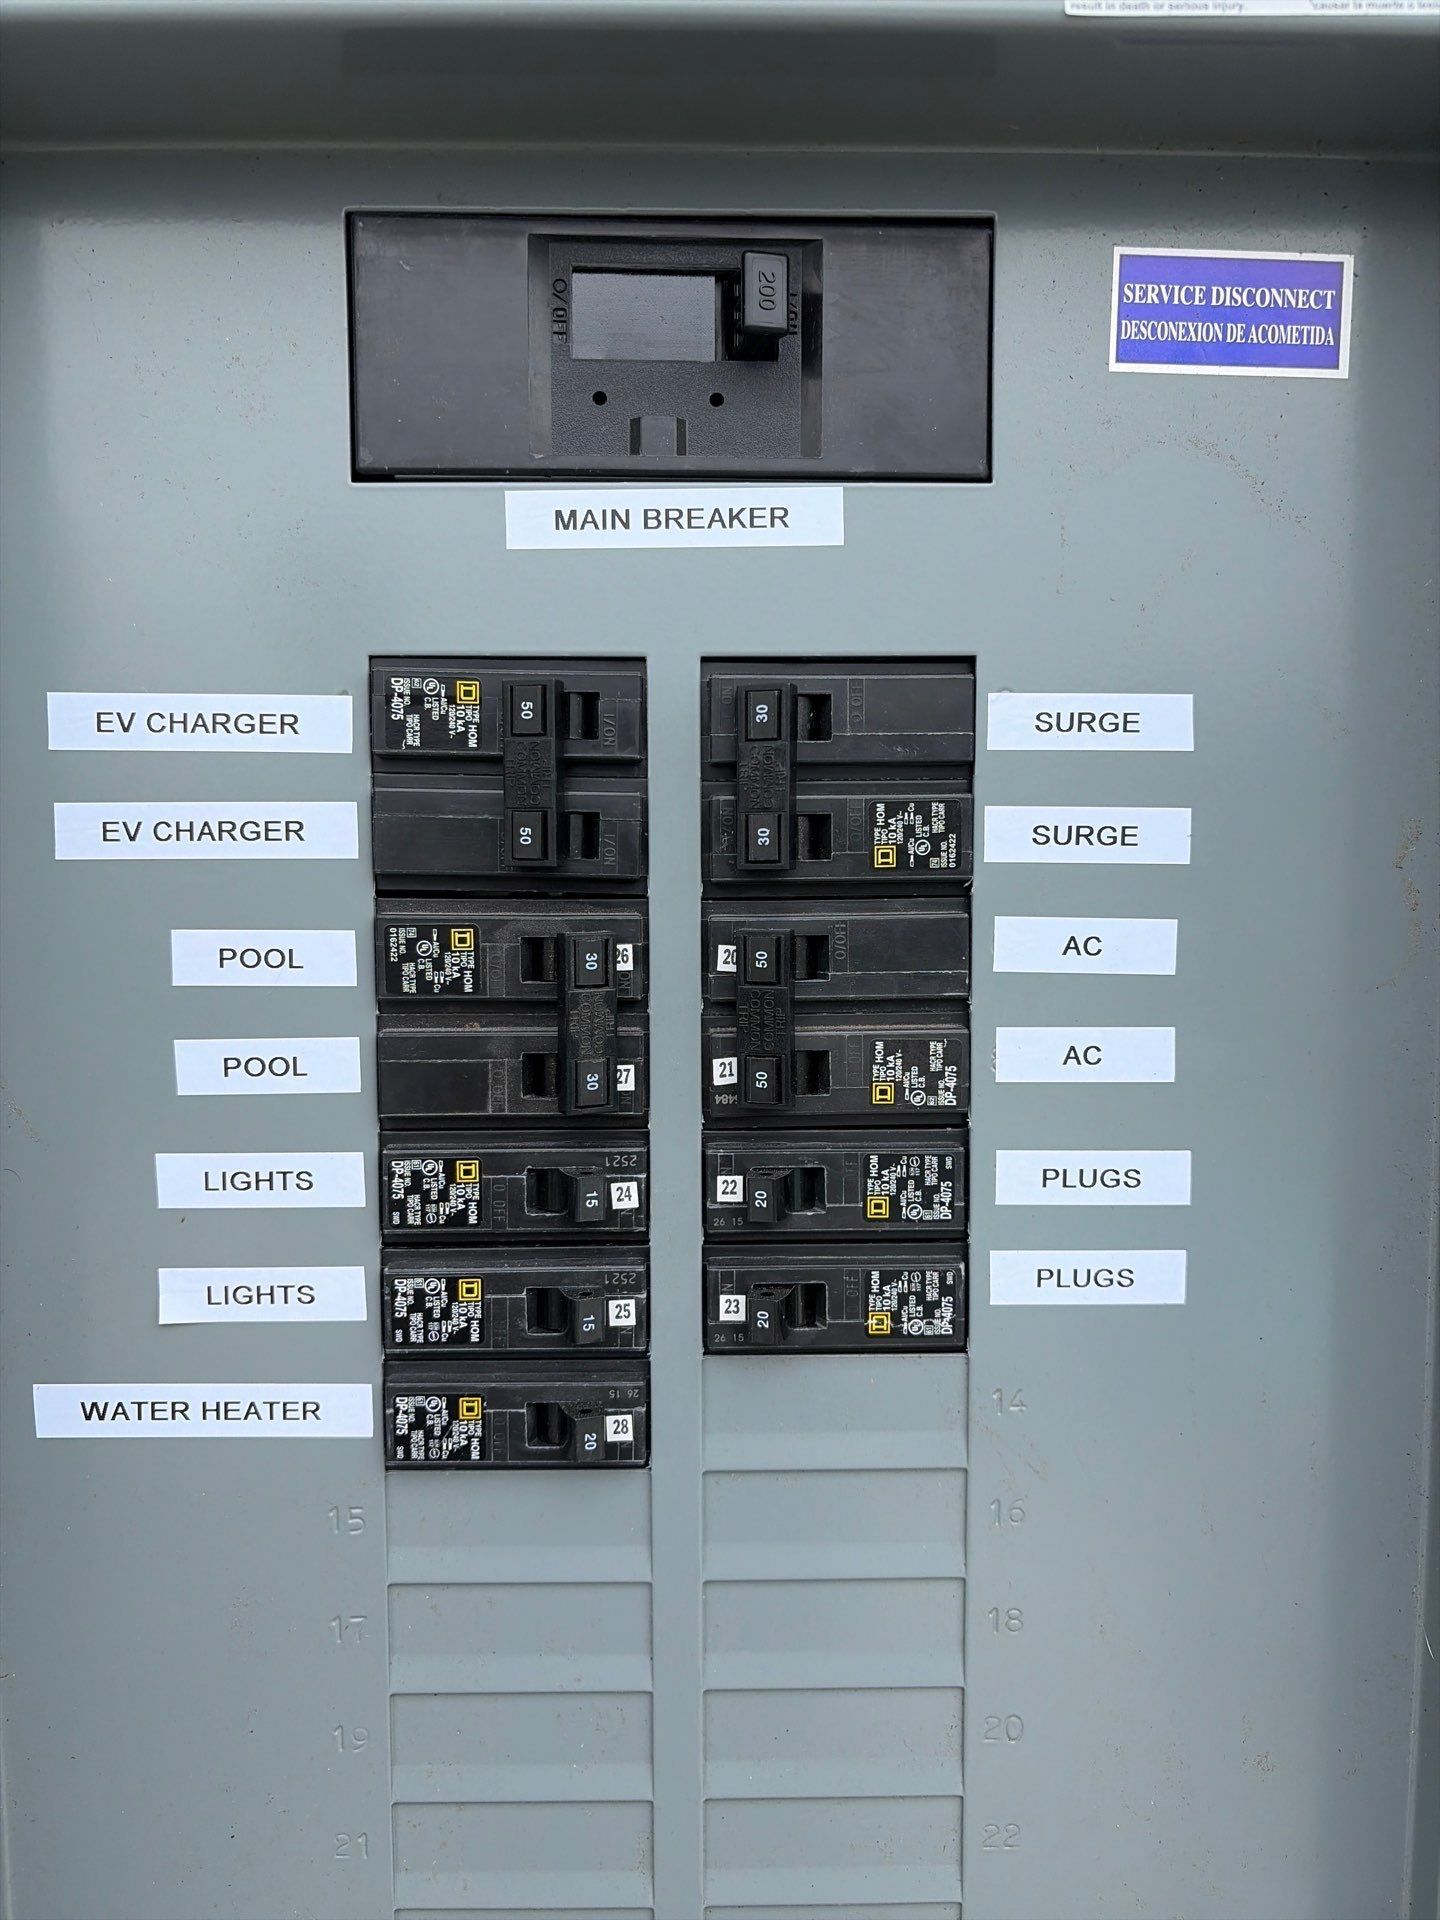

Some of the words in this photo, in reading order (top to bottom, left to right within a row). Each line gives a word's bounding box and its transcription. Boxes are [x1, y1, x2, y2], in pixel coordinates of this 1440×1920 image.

[758, 270, 776, 311] 200
[1123, 283, 1206, 305] SERVICE
[1211, 286, 1336, 309] DISCONNECT
[1121, 320, 1222, 342] DESCONEXION
[1226, 324, 1246, 343] DE
[1248, 324, 1335, 345] ACOMETIDA
[555, 508, 631, 531] MAIN
[643, 506, 790, 530] BREAKER
[391, 678, 403, 720] DP-4075
[456, 705, 465, 717] 10
[521, 702, 533, 719] 50
[756, 704, 768, 723] 30
[96, 712, 137, 732] EV
[146, 712, 300, 734] CHARGER
[456, 720, 465, 732] kA
[604, 714, 616, 746] I/ON
[1034, 712, 1140, 733] SURGE
[469, 725, 477, 747] HOM
[876, 804, 885, 825] HOM
[888, 818, 896, 830] kA
[102, 821, 142, 842] EV
[153, 820, 305, 841] CHARGER
[520, 827, 531, 844] 50
[758, 828, 770, 846] 30
[889, 833, 896, 844] 10
[1032, 825, 1138, 846] SURGE
[604, 835, 615, 865] I/ON
[1062, 936, 1102, 956] AC
[219, 948, 304, 969] POOL
[452, 951, 460, 963] 10
[585, 953, 597, 970] 30
[756, 951, 767, 968] 50
[452, 966, 460, 978] kA
[464, 971, 472, 992] HOM
[875, 1042, 884, 1062] HOM
[887, 1055, 894, 1067] kA
[1063, 1046, 1102, 1066] AC
[223, 1056, 308, 1077] POOL
[719, 1061, 734, 1078] 21
[887, 1070, 895, 1081] 10
[587, 1073, 598, 1090] 30
[617, 1069, 630, 1084] 27
[756, 1072, 767, 1088] 50
[945, 1066, 956, 1105] DP-4075
[715, 1095, 737, 1104] 484
[605, 1155, 637, 1166] 2521
[870, 1155, 878, 1176] HOM
[204, 1171, 314, 1191] LIGHTS
[392, 1161, 404, 1199] DP-4075
[881, 1169, 889, 1181] kA
[1042, 1168, 1142, 1188] PLUGS
[457, 1183, 465, 1195] 10
[616, 1186, 632, 1202] 24
[722, 1180, 737, 1195] 22
[881, 1184, 889, 1195] 10
[457, 1198, 465, 1210] kA
[586, 1191, 598, 1208] 15
[755, 1191, 766, 1208] 20
[940, 1181, 952, 1219] DP-4075
[469, 1202, 477, 1224] HOM
[714, 1218, 725, 1226] 26
[732, 1218, 743, 1226] 15
[605, 1273, 636, 1284] 2521
[871, 1271, 879, 1292] HOM
[1036, 1268, 1134, 1288] PLUGS
[207, 1285, 316, 1305] LIGHTS
[395, 1279, 406, 1317] DP-4075
[883, 1285, 890, 1296] kA
[459, 1302, 467, 1313] 10
[615, 1303, 630, 1319] 25
[725, 1299, 740, 1314] 23
[883, 1299, 890, 1311] 10
[459, 1316, 467, 1328] kA
[583, 1315, 594, 1331] 15
[757, 1311, 769, 1328] 20
[941, 1296, 953, 1334] DP-4075
[471, 1320, 479, 1341] HOM
[715, 1334, 725, 1342] 26
[733, 1333, 744, 1341] 15
[609, 1390, 620, 1398] 15
[992, 1388, 1027, 1415] 14
[80, 1401, 190, 1420] WATER
[202, 1401, 321, 1420] HEATER
[396, 1397, 408, 1435] DP-4075
[460, 1421, 467, 1432] 10
[613, 1419, 628, 1434] 28
[460, 1434, 468, 1446] kA
[471, 1438, 479, 1460] HOM
[585, 1433, 596, 1450] 20
[328, 1506, 367, 1534] 15
[989, 1498, 1025, 1526] 16
[329, 1615, 368, 1643] 17
[987, 1607, 1024, 1634] 18
[332, 1724, 369, 1752] 19
[983, 1715, 1024, 1743] 20
[983, 1823, 1022, 1849] 22
[334, 1832, 369, 1860] 21
